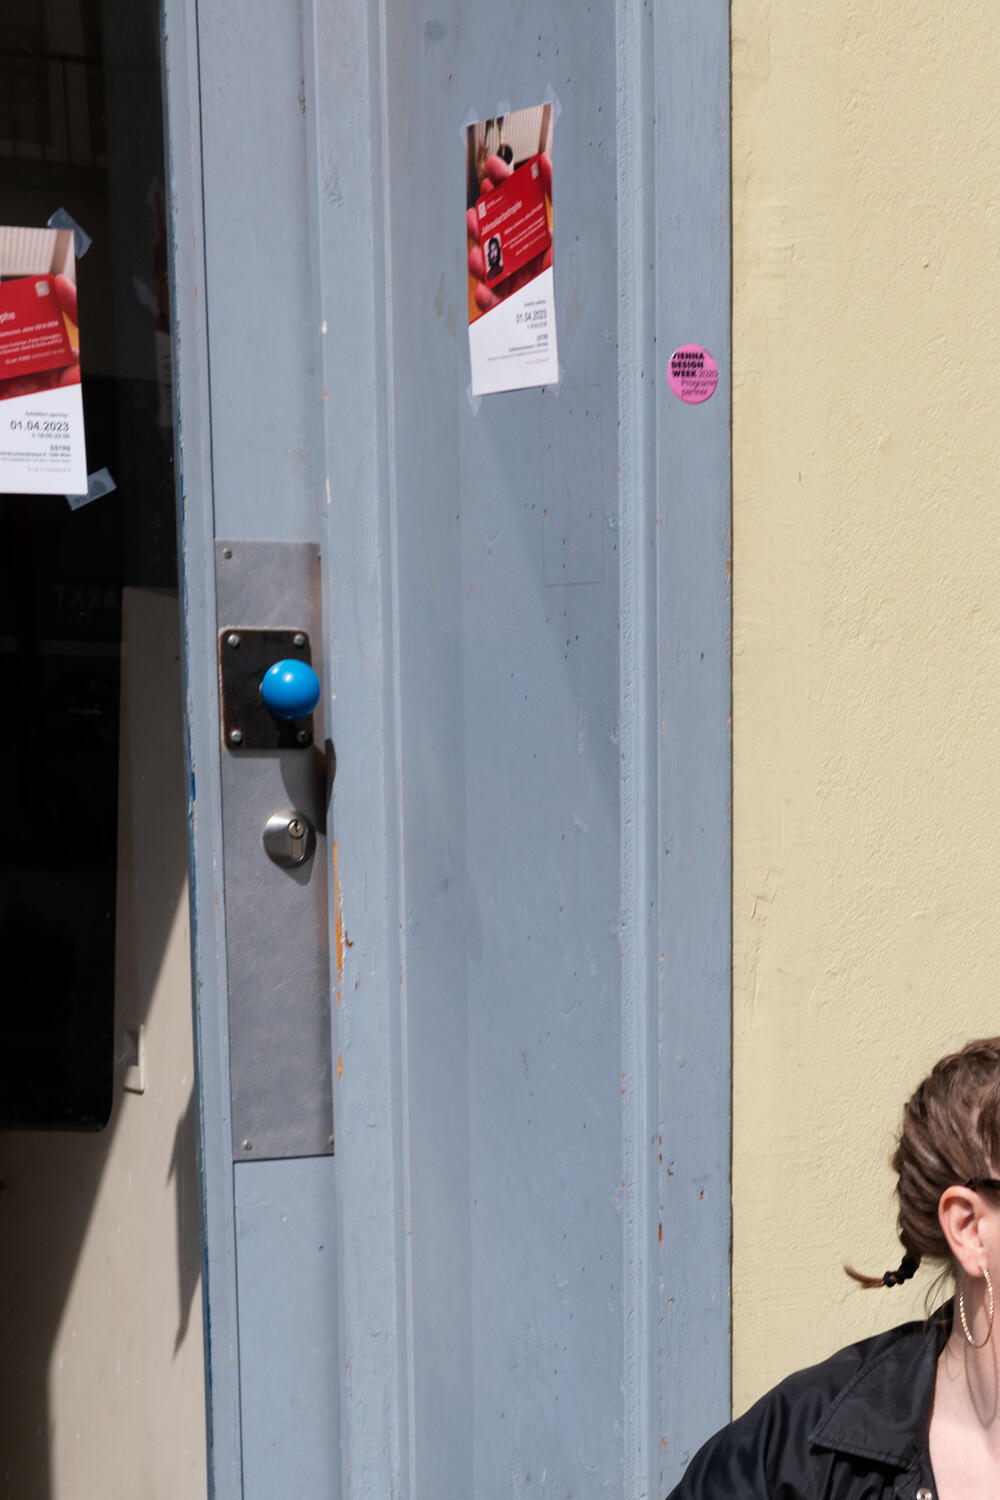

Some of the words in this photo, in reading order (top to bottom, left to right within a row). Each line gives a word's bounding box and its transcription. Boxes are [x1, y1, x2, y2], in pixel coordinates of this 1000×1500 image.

[672, 352, 704, 360] VIENNA
[671, 361, 704, 369] DESIGN
[672, 370, 697, 378] WEEK
[10, 420, 70, 432] 01.04.2023
